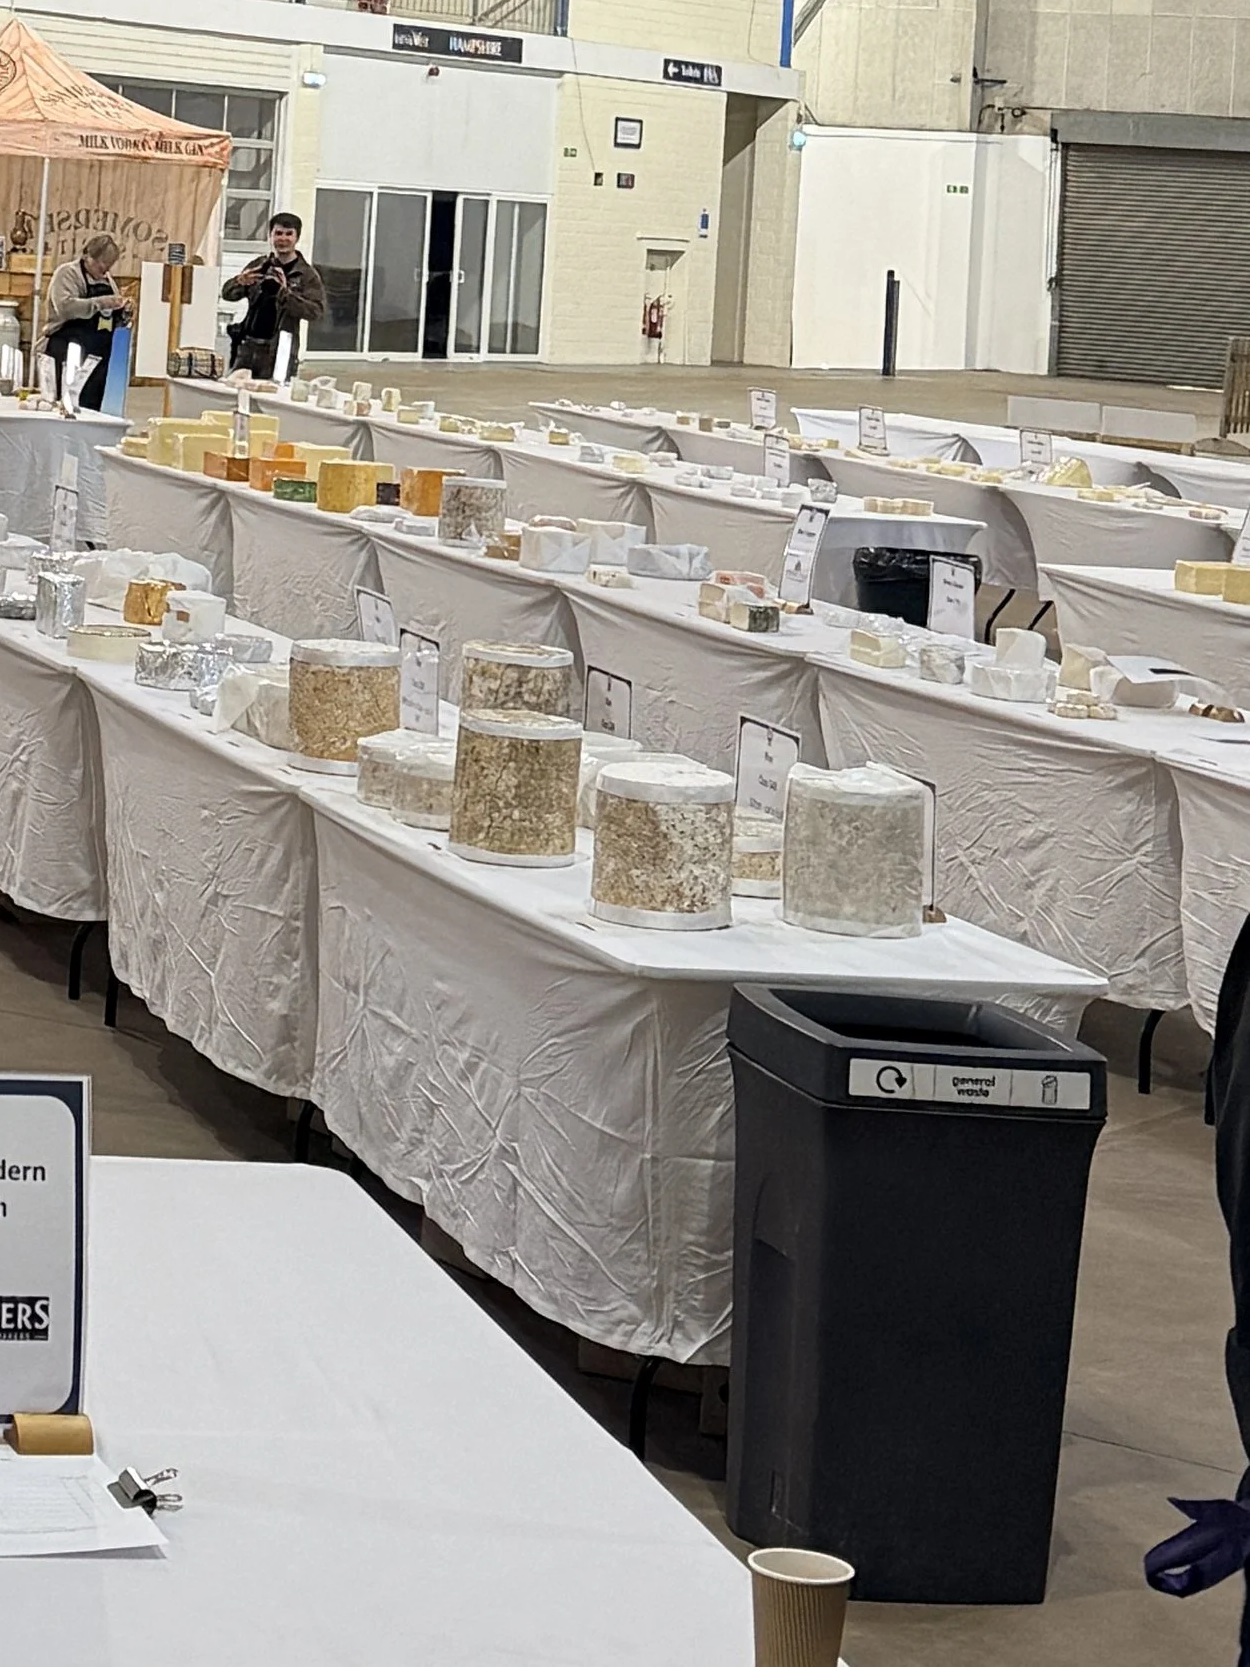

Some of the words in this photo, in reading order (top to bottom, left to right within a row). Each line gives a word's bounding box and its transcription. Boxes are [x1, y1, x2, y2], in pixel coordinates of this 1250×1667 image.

[80, 134, 109, 149] MILK
[953, 1076, 996, 1088] general
[957, 1088, 990, 1098] waste
